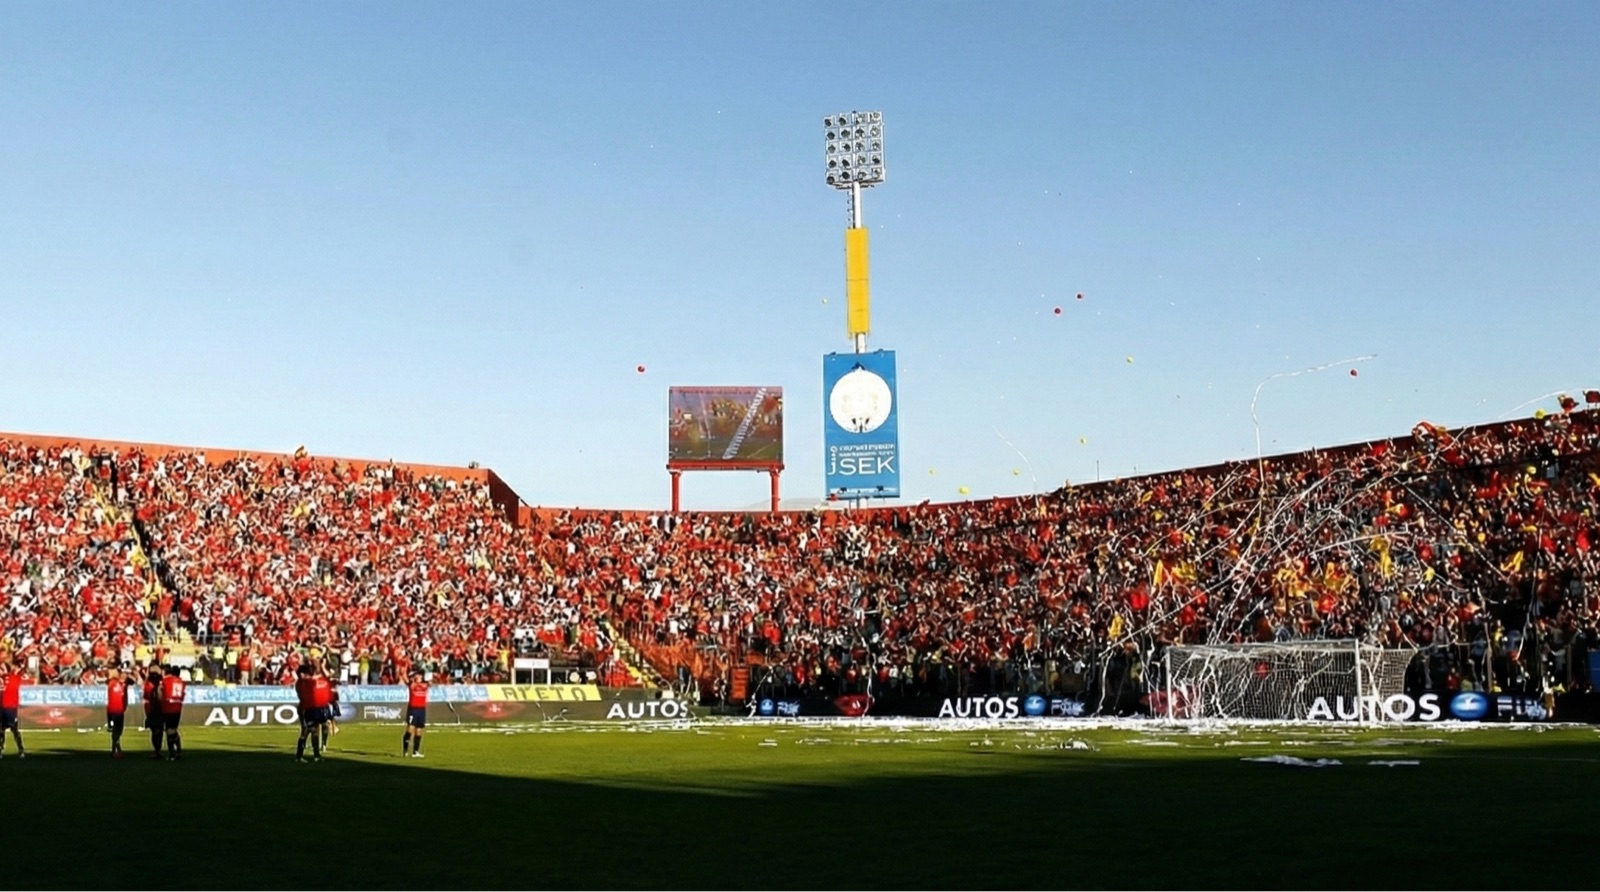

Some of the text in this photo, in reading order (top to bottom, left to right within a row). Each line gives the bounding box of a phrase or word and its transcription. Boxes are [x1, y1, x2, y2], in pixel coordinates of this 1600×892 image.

[204, 704, 299, 726] AUTO
[606, 700, 688, 719] AUTOS
[938, 697, 1019, 718] AUTOS
[1307, 693, 1441, 721] AUTOS
